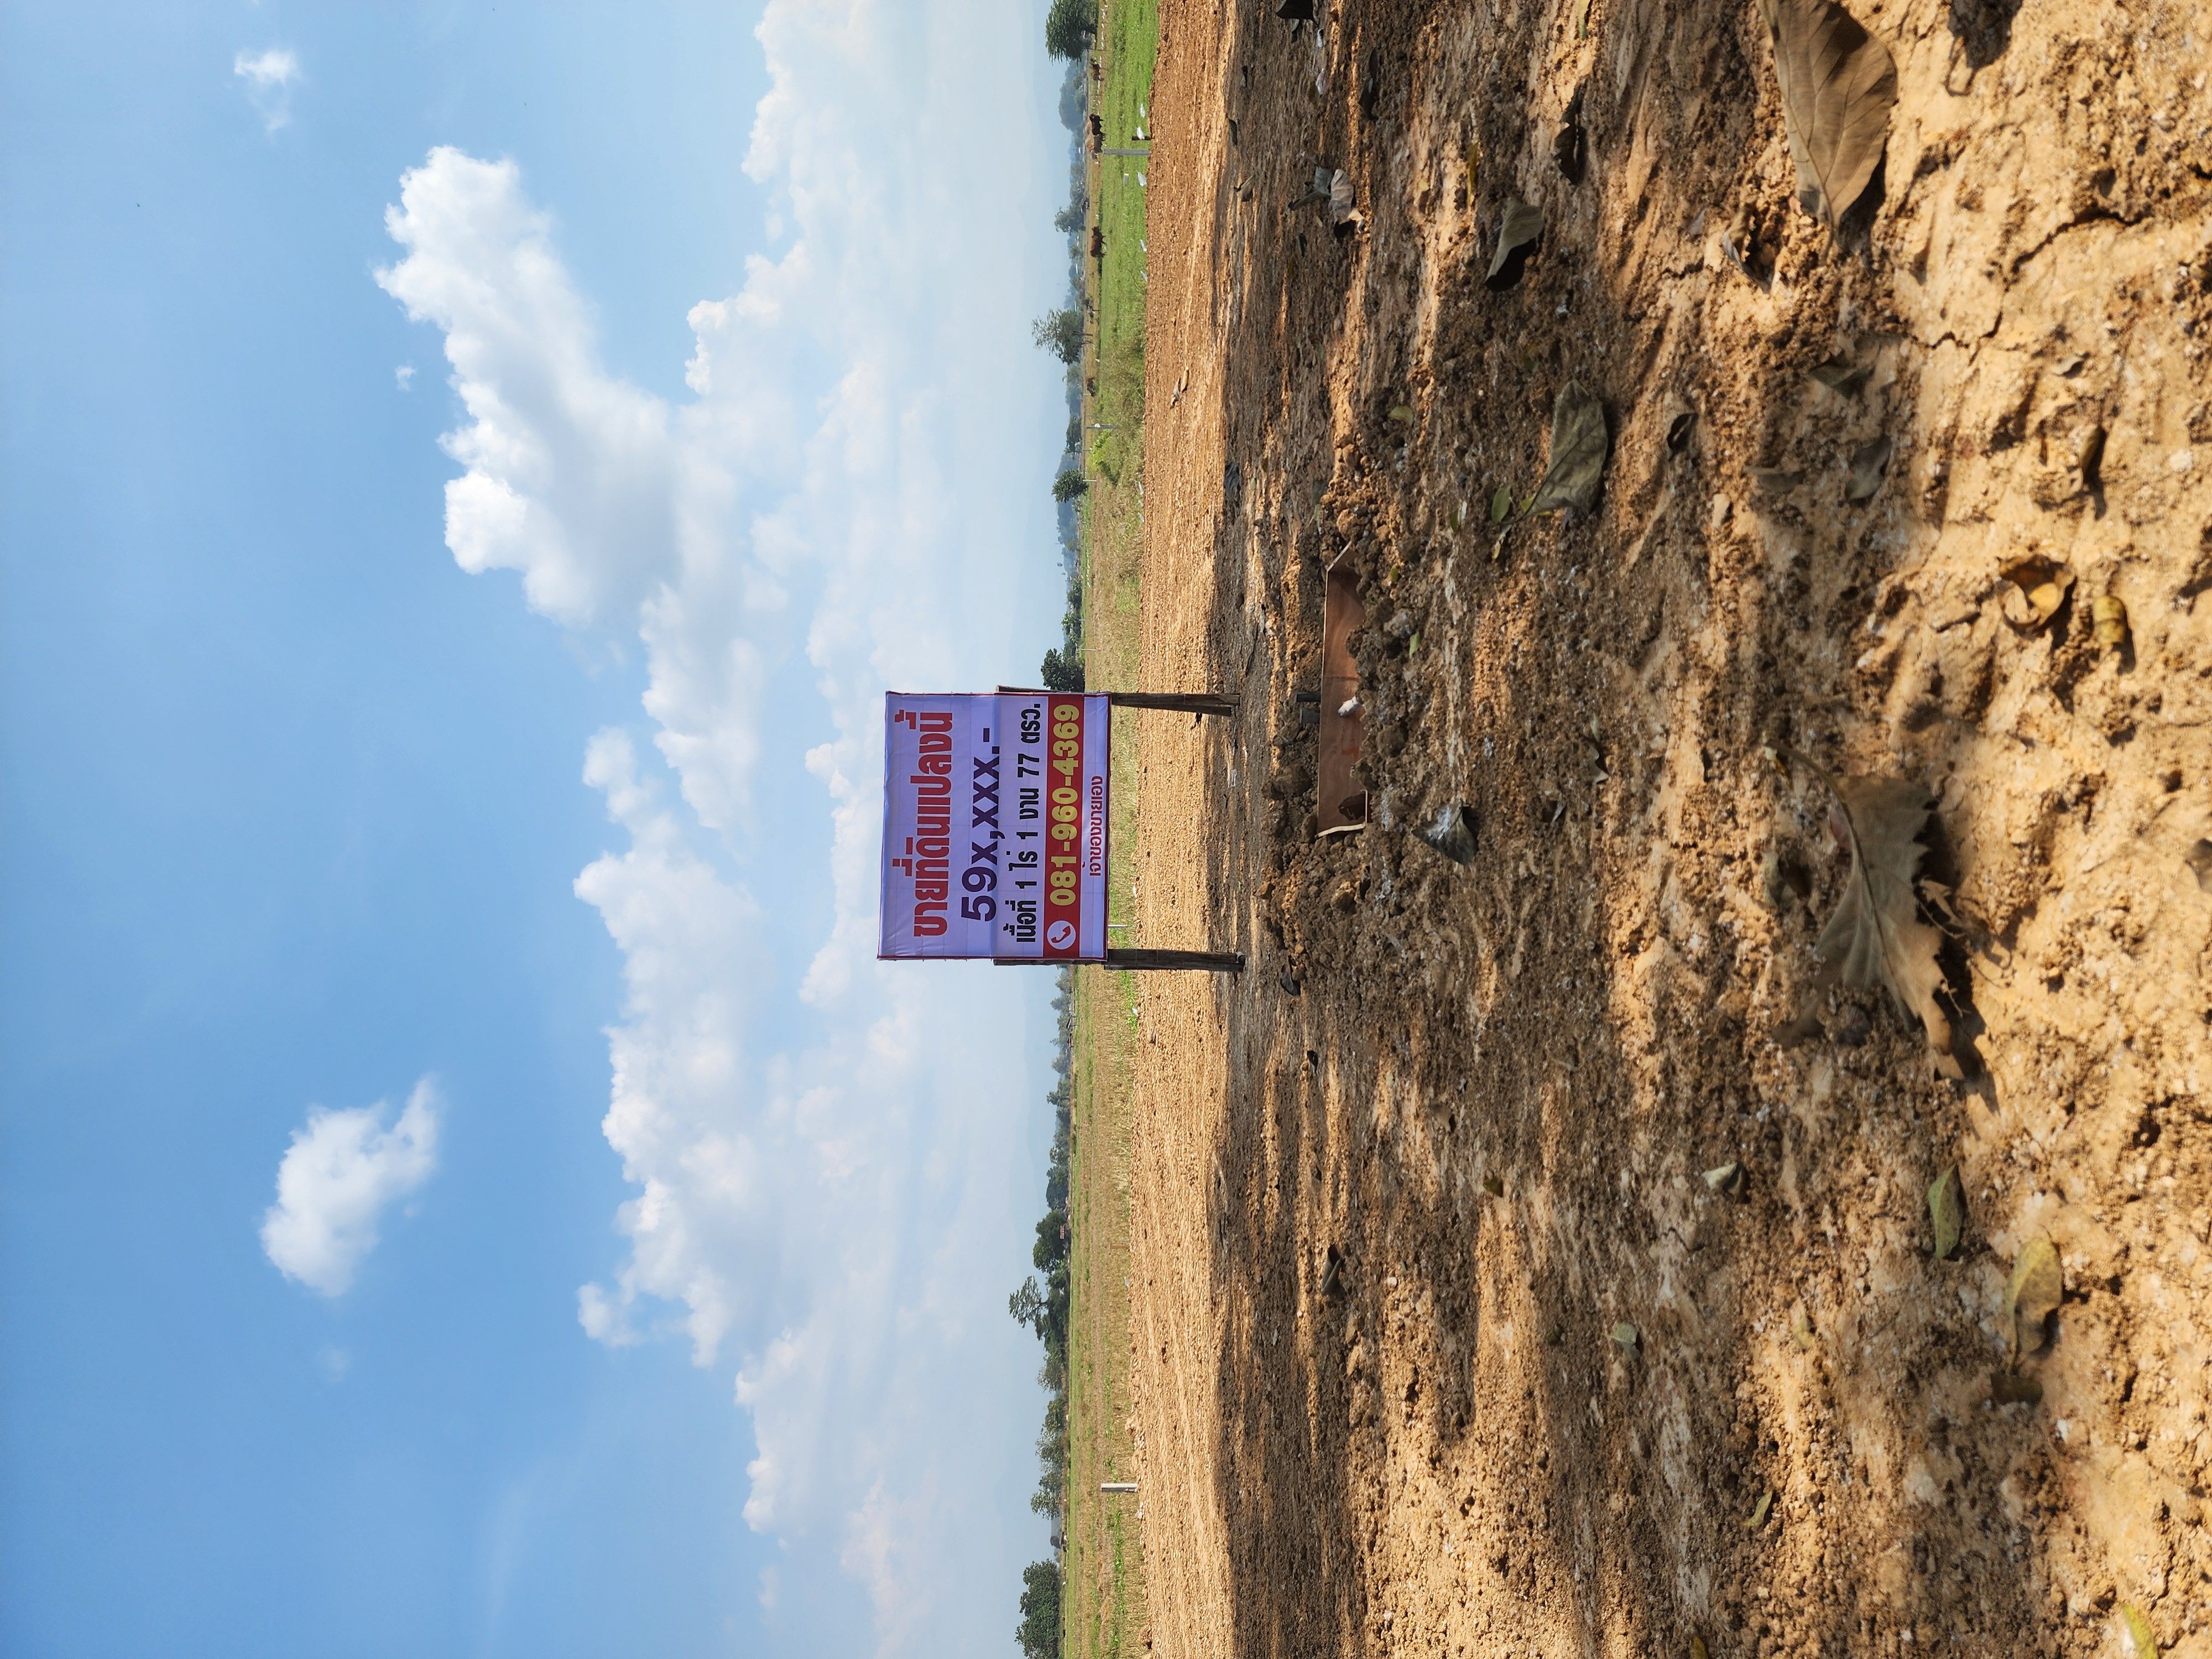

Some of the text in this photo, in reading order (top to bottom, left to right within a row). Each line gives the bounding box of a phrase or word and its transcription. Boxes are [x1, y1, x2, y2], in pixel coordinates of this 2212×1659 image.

[1020, 703, 1041, 743] ตรว.
[1018, 753, 1040, 778] 77
[1019, 788, 1039, 820] งาน
[1050, 704, 1079, 906] 081-960-4369
[893, 709, 953, 937] ขายที่ดินแปลงนี้
[1016, 831, 1039, 840] 1
[1006, 851, 1038, 872] ไร่
[1003, 899, 1037, 942] เนื้อที่
